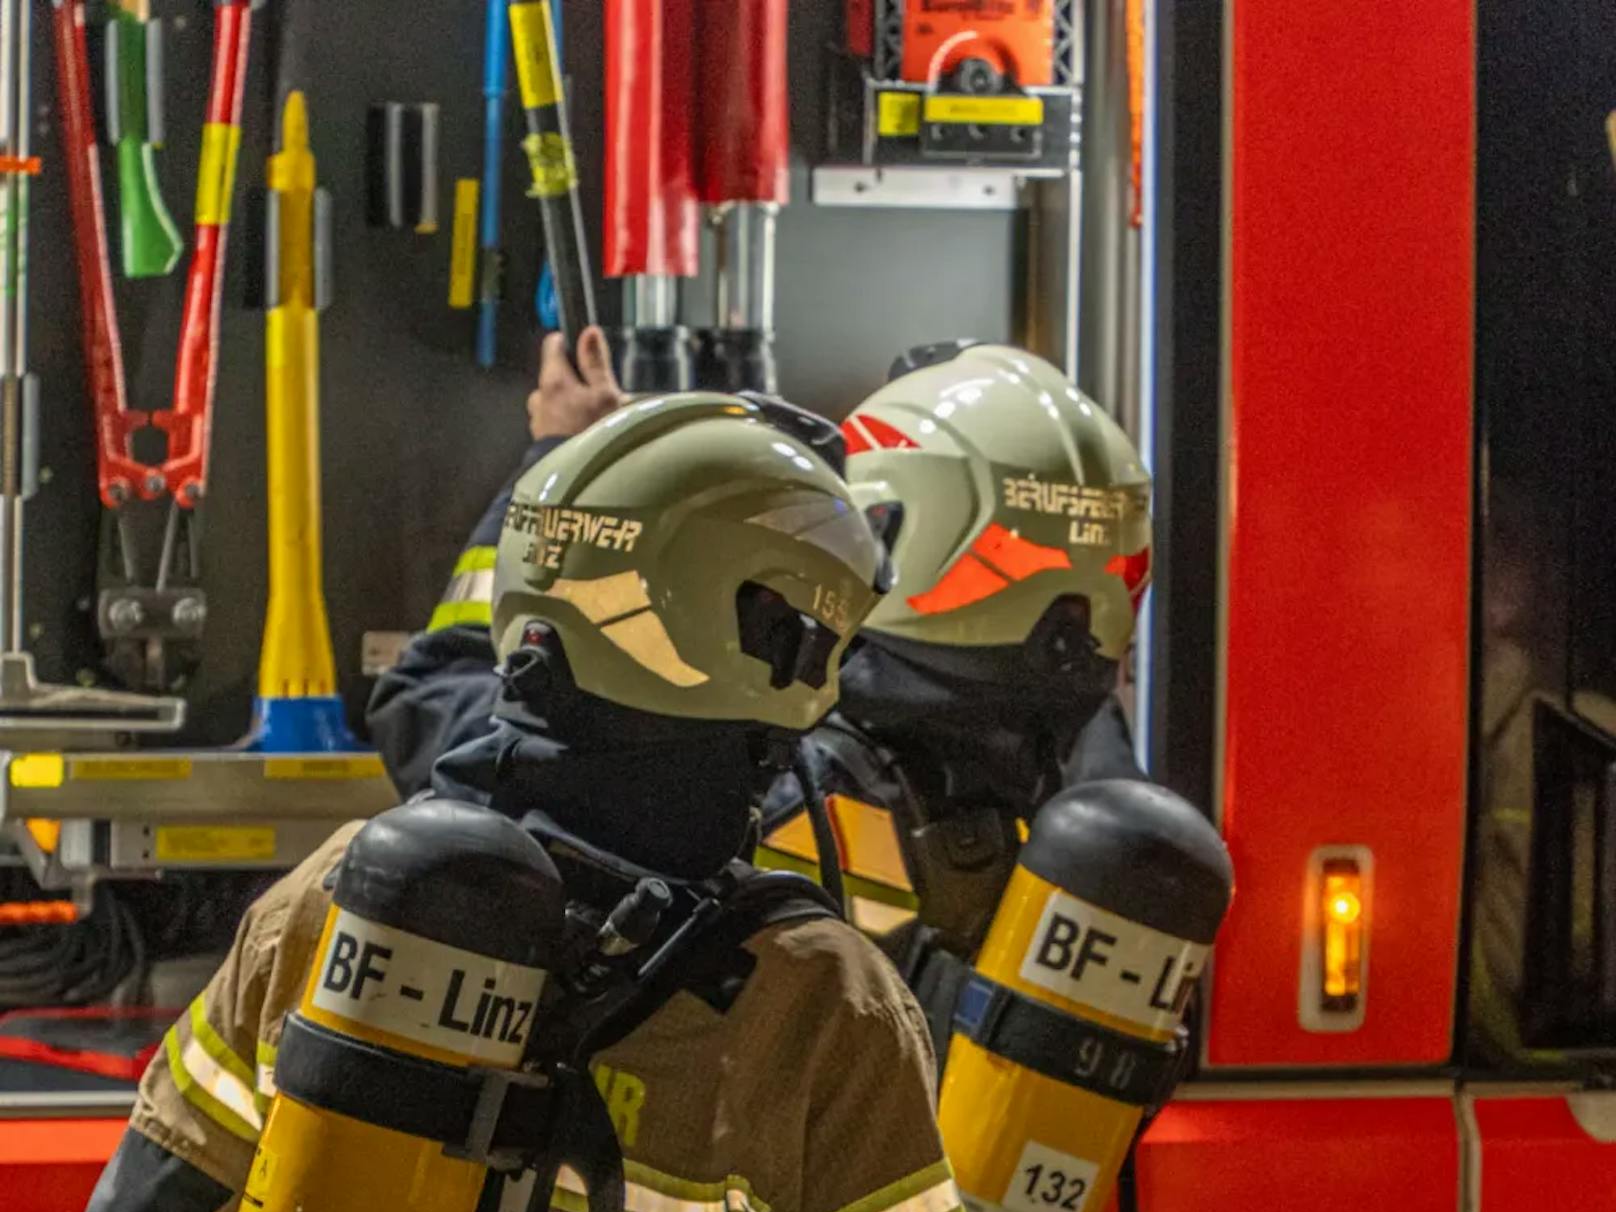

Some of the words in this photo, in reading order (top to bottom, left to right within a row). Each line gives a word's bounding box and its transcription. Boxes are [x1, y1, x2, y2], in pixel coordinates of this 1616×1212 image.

[1035, 912, 1117, 982] BF
[323, 931, 393, 1001] BF
[438, 969, 533, 1044] Linz
[1023, 1163, 1087, 1212] 132
